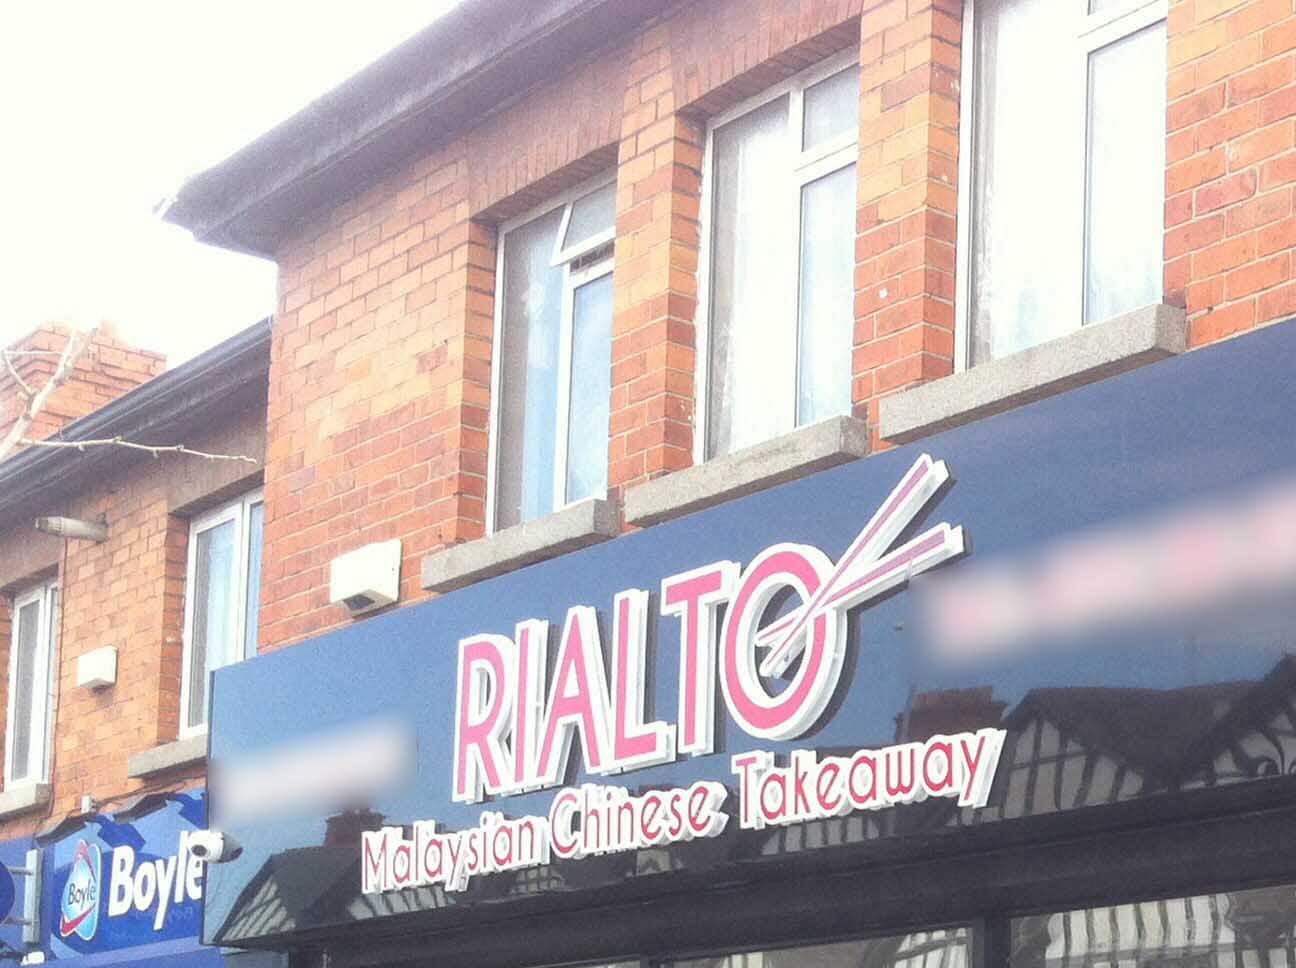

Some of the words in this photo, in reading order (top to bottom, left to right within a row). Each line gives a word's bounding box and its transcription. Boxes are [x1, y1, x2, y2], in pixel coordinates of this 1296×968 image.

[452, 540, 849, 803] RIALTO
[360, 810, 550, 893] Malaysian
[549, 777, 729, 859] Chinese
[731, 727, 1007, 829] Takeaway
[69, 879, 96, 911] Boyle
